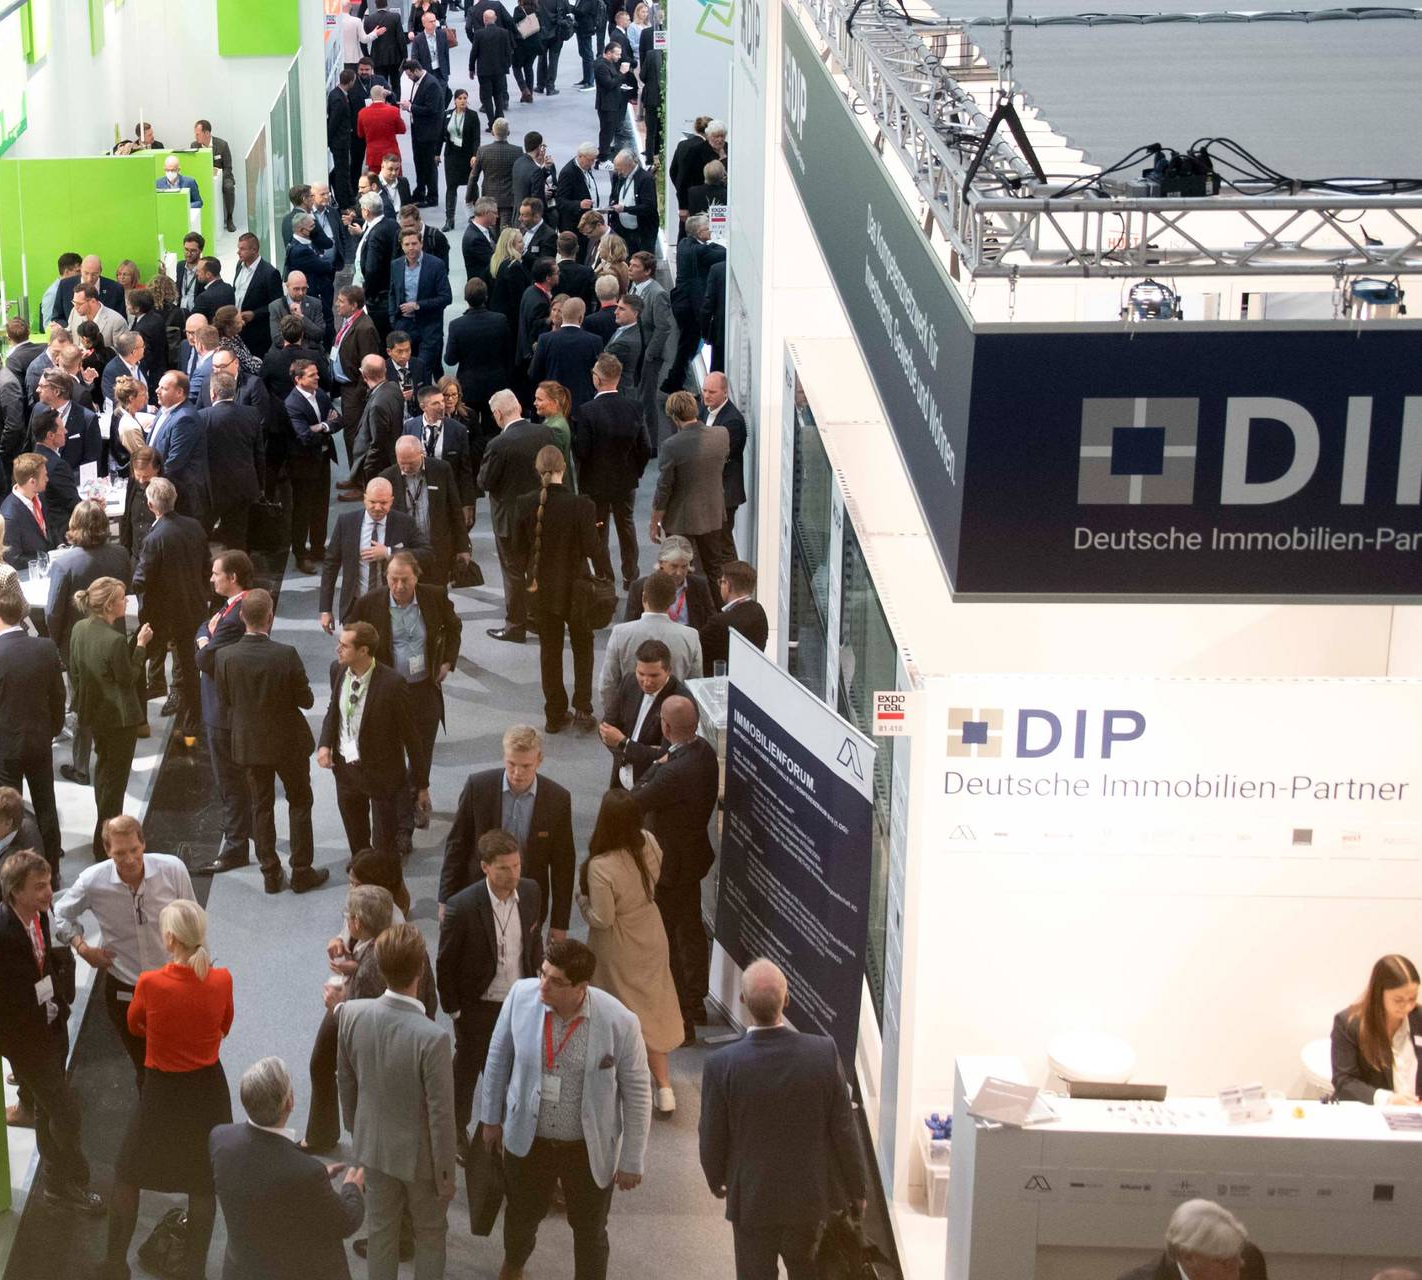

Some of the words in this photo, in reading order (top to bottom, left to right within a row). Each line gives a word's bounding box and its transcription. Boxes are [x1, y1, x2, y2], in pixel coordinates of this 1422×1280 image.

[791, 55, 807, 141] DIP
[867, 203, 876, 246] Das
[876, 220, 928, 353] Kompetenznetzwerk
[917, 376, 929, 422] und
[929, 393, 955, 486] Wohnen.
[1074, 525, 1202, 551] Deutsche
[878, 695, 905, 705] expo
[1016, 708, 1147, 759] DIP
[734, 709, 816, 794] IMMOBILIENFORUM.
[944, 771, 1090, 797] Deutsche
[1102, 773, 1409, 801] Immobilien-Partner
